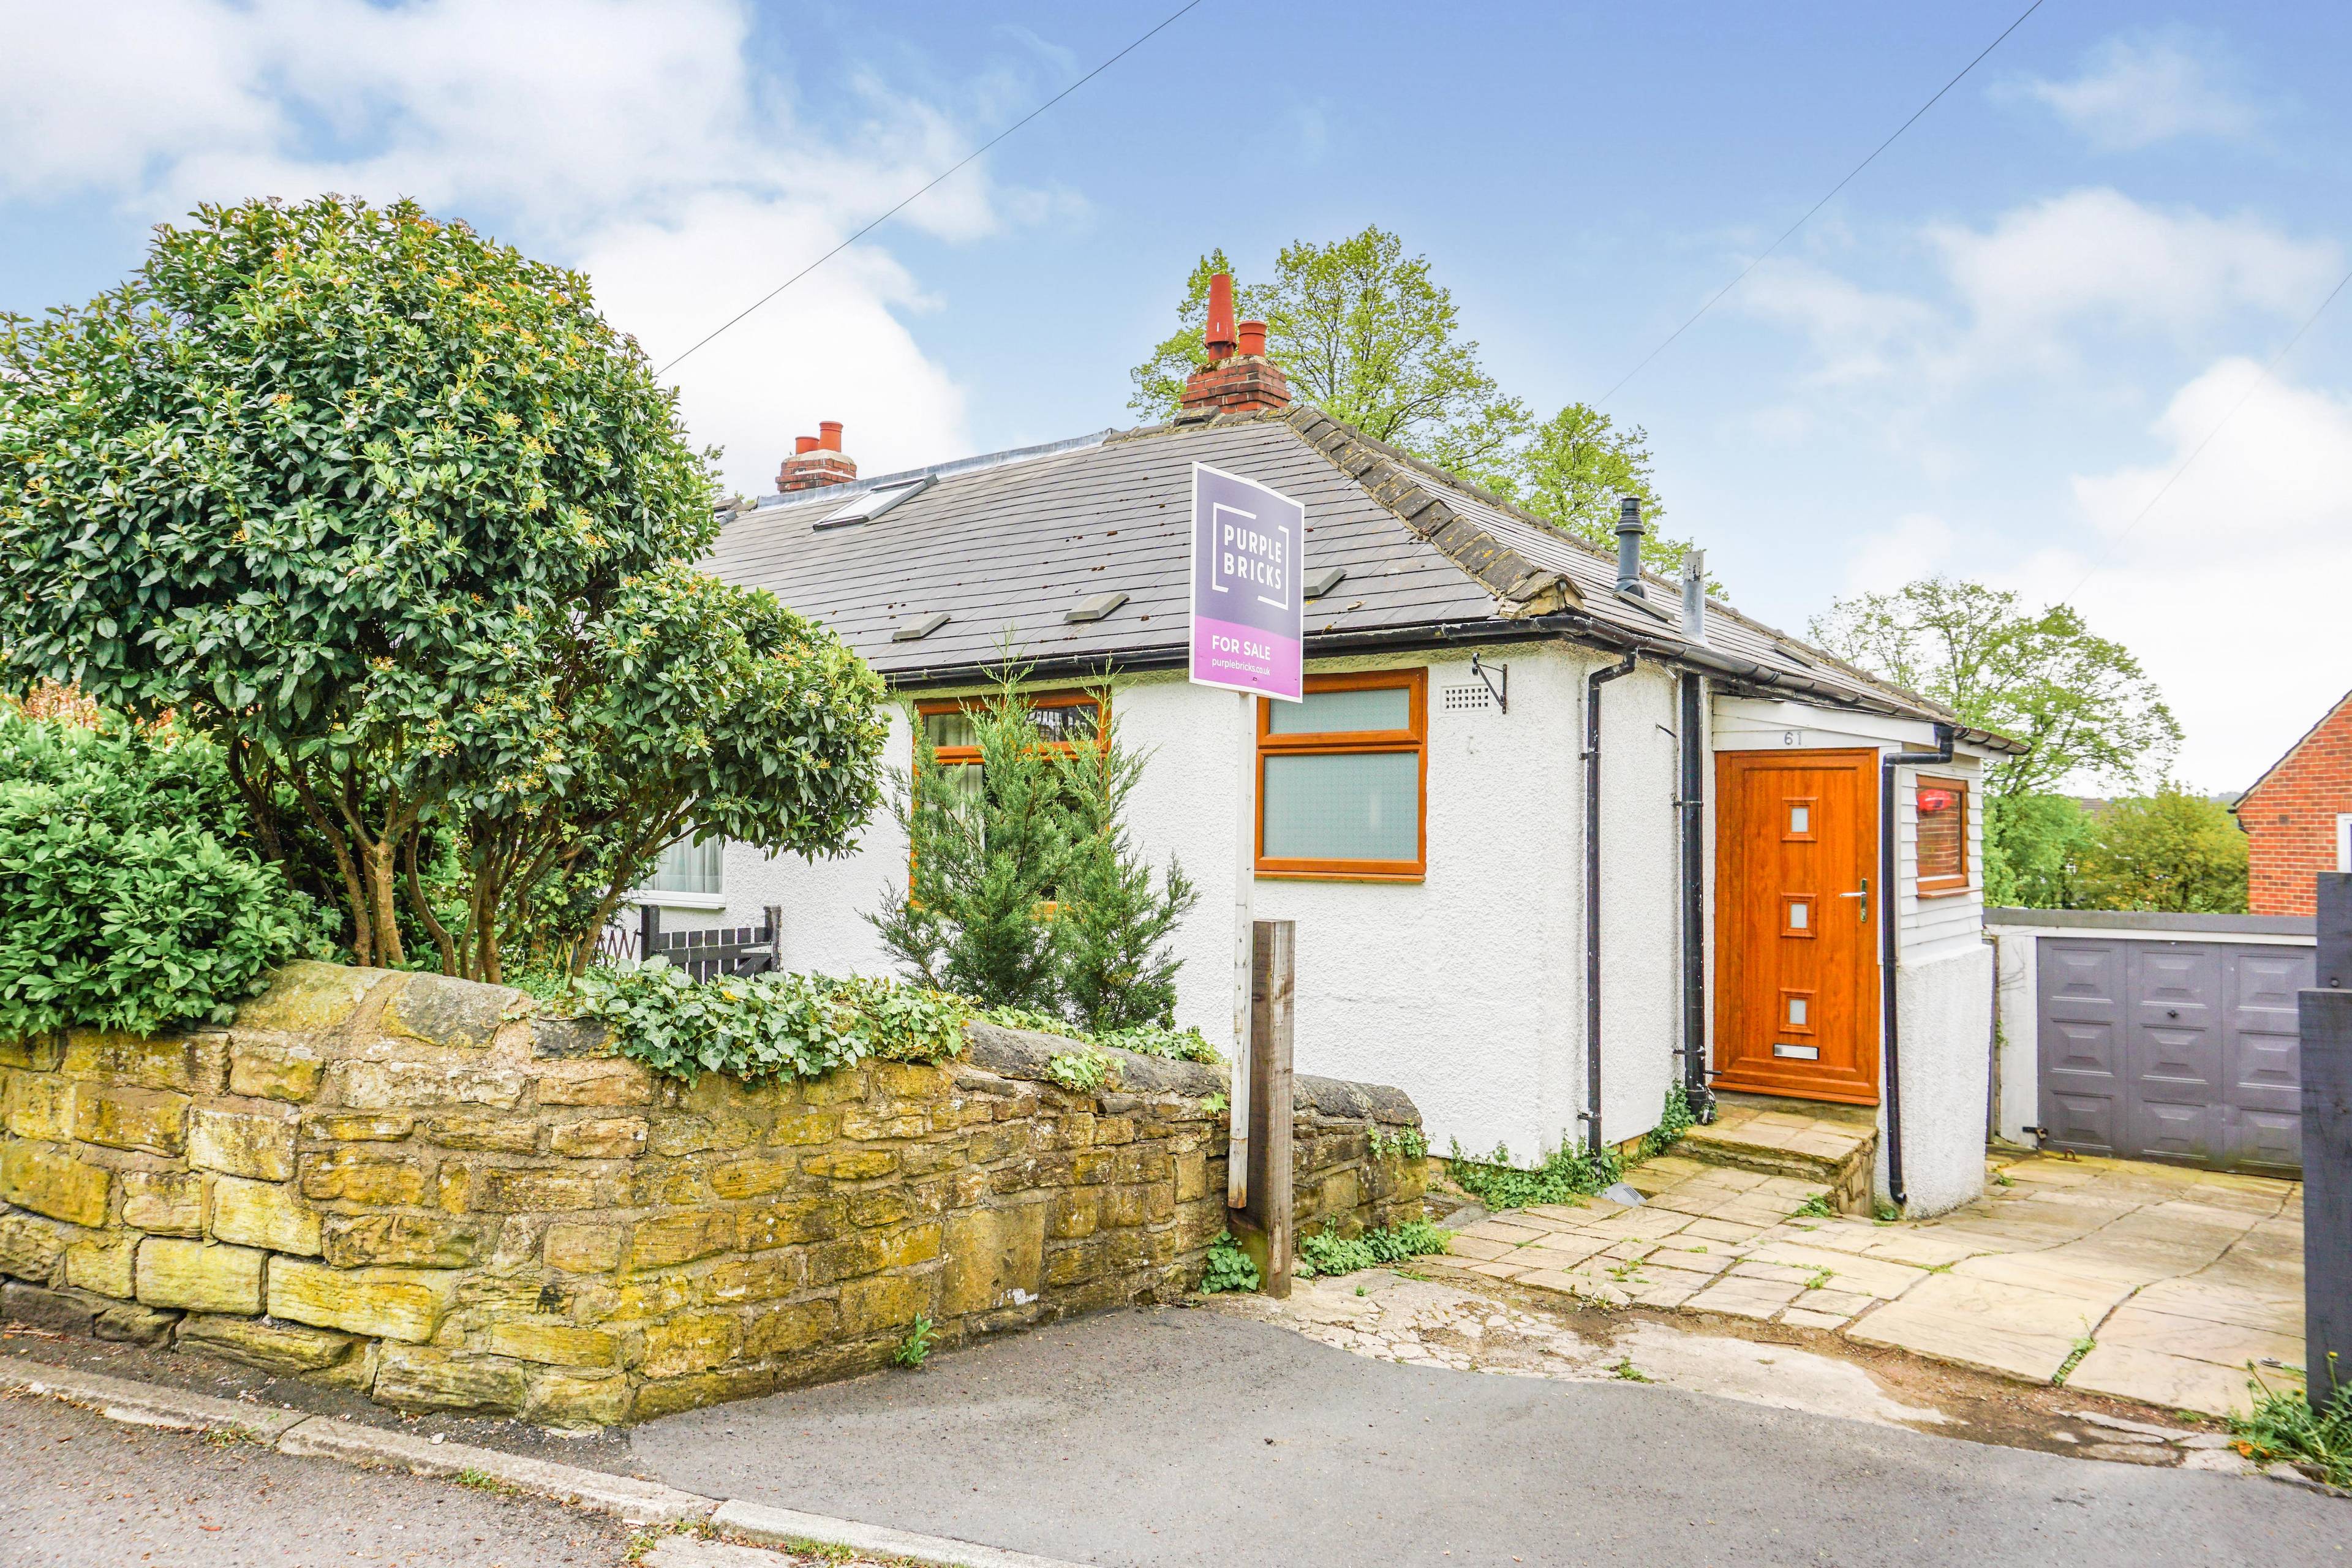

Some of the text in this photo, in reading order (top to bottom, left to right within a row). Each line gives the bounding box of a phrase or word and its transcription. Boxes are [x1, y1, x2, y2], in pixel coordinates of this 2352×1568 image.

[1224, 524, 1282, 564] PURPLE
[1224, 552, 1281, 590] BRICKS
[1212, 635, 1271, 661] FOR SALE
[1212, 658, 1270, 676] purplebricks.co.uk
[1784, 731, 1801, 745] 61
